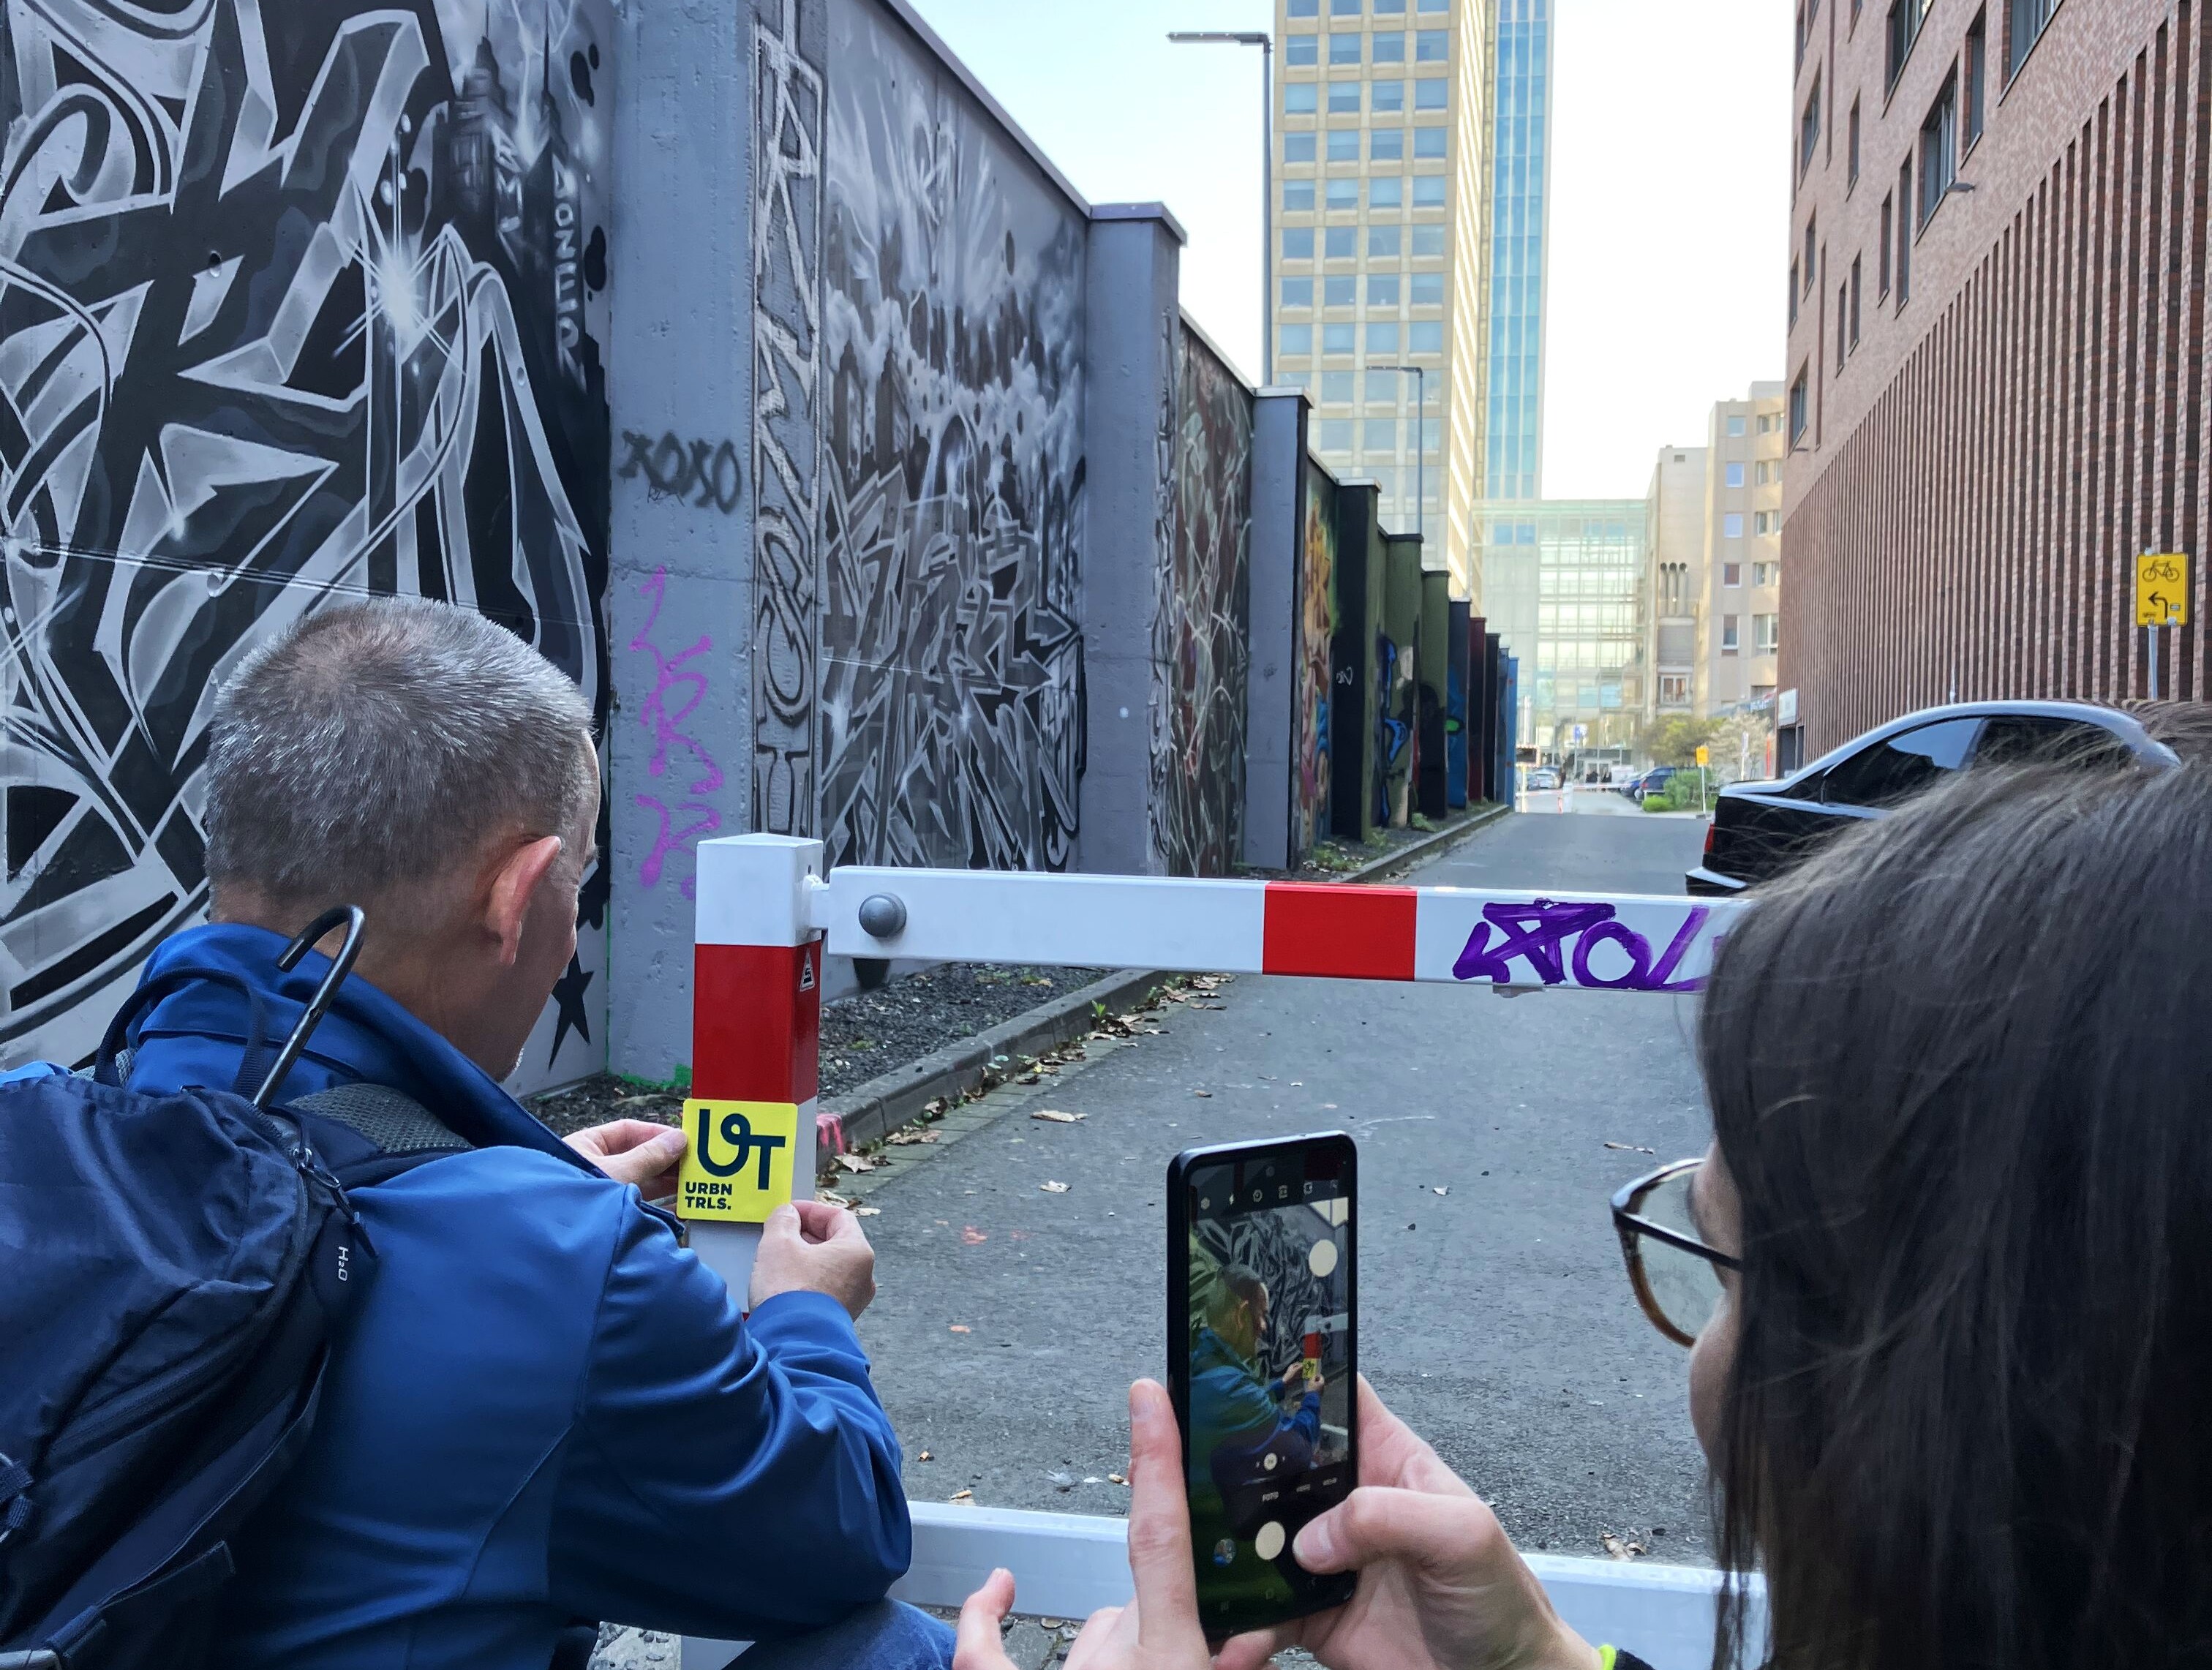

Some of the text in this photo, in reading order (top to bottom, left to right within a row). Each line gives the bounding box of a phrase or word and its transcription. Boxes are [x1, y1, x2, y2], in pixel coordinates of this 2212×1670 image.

[617, 430, 742, 515] XOXO
[685, 1181, 733, 1195] URBN
[685, 1195, 732, 1211] TRLS.
